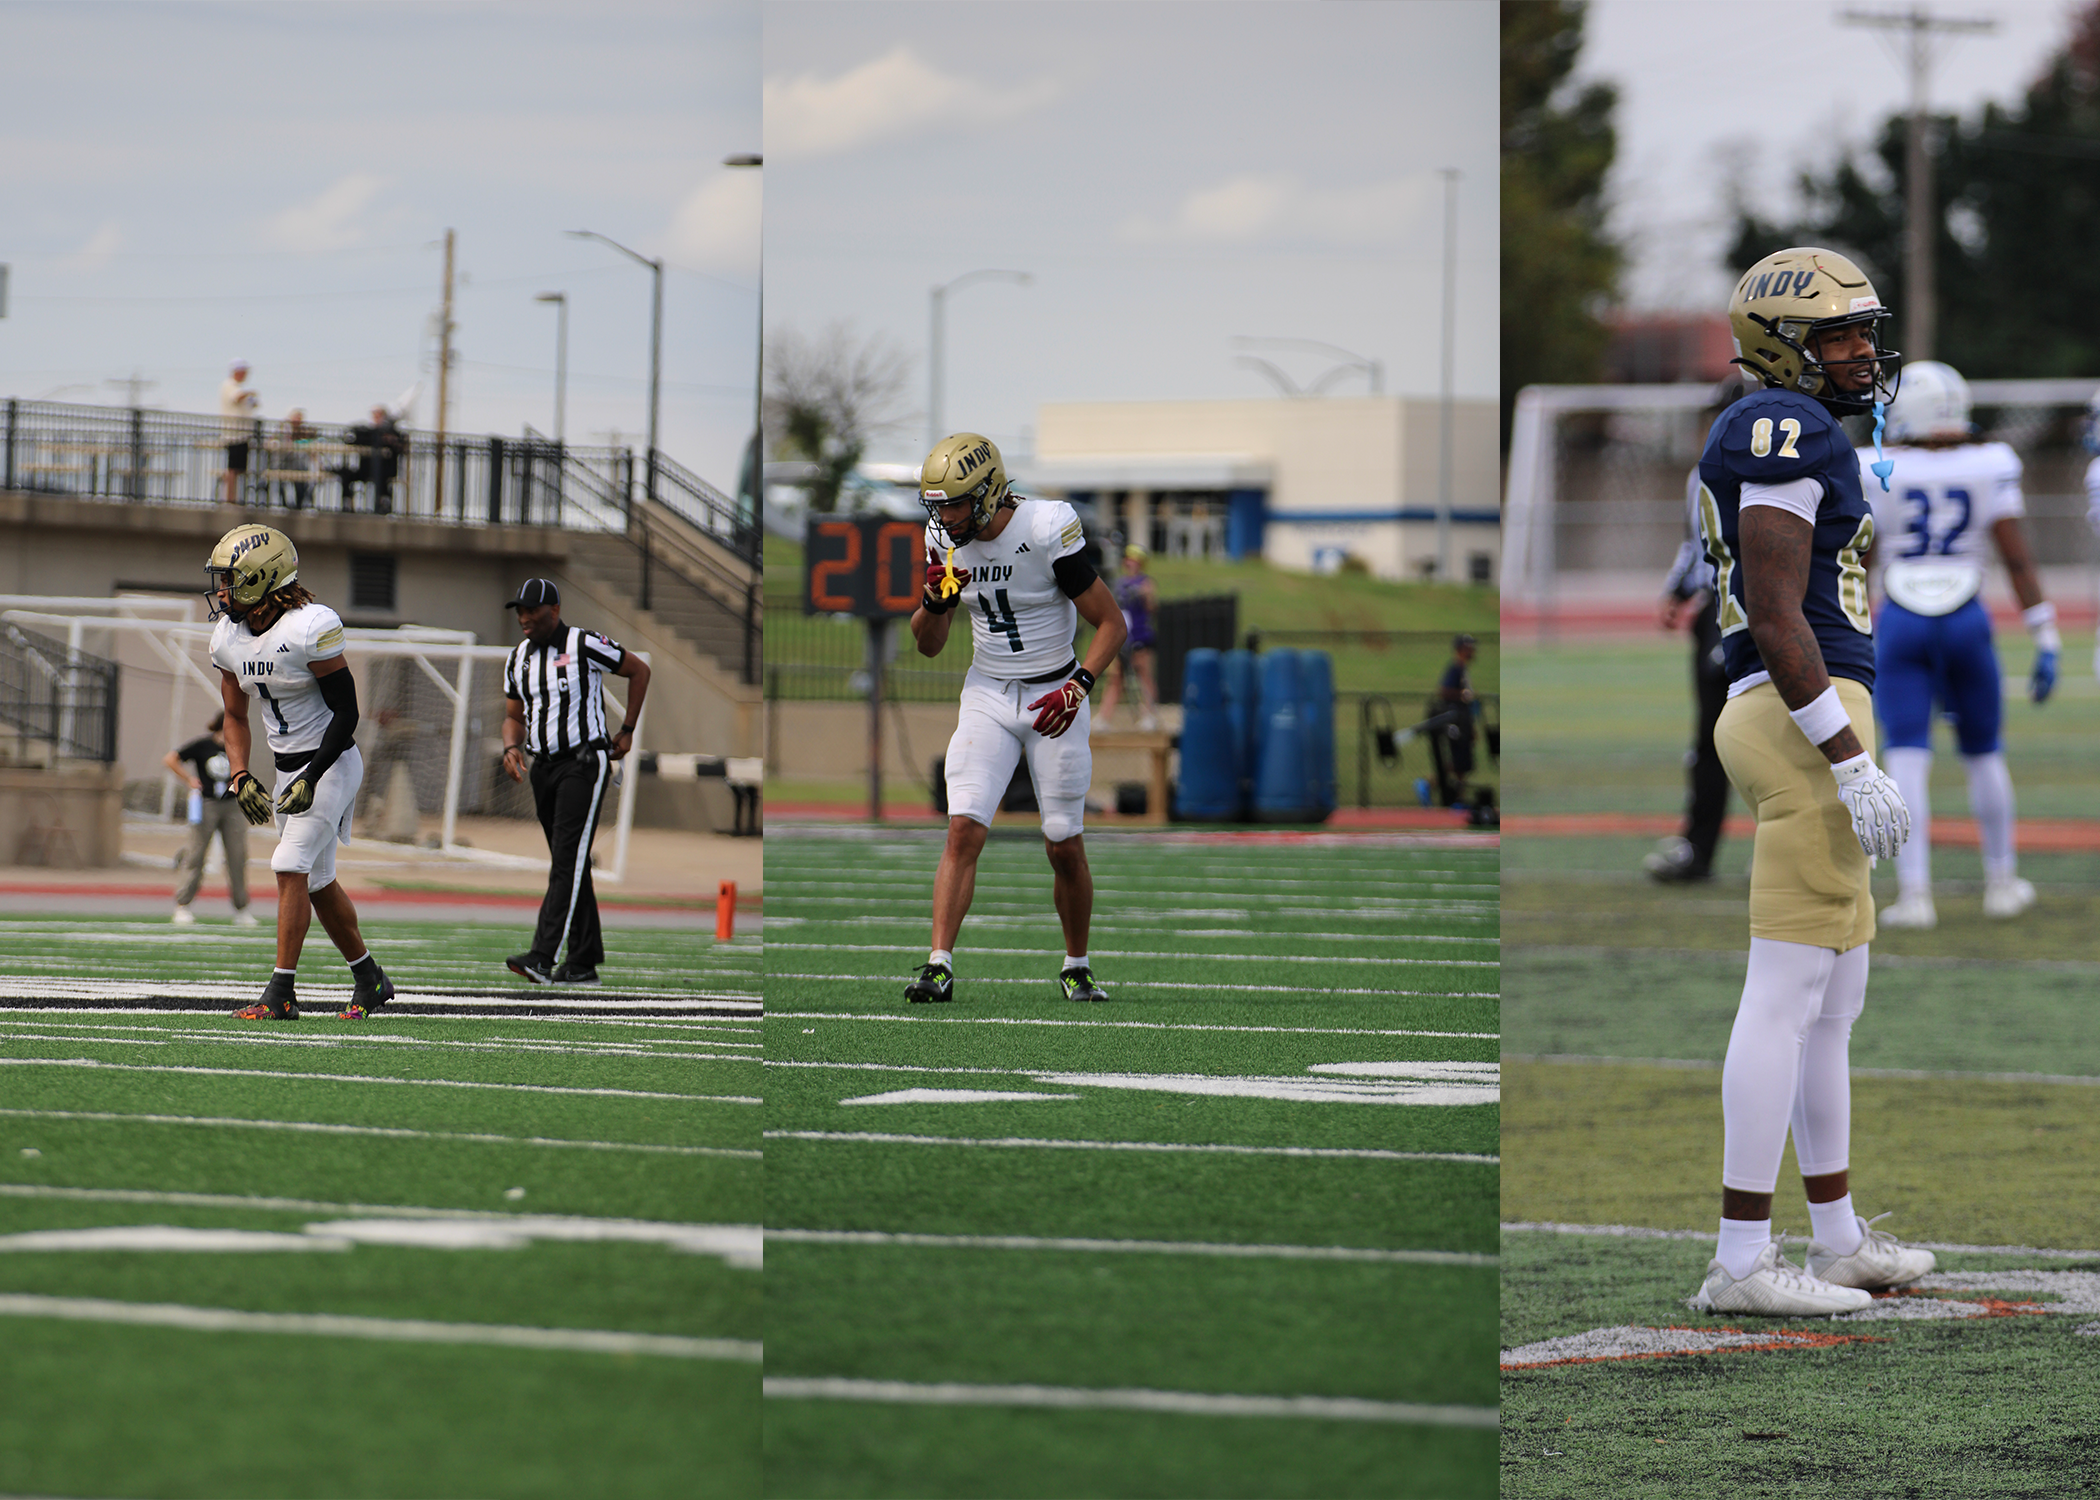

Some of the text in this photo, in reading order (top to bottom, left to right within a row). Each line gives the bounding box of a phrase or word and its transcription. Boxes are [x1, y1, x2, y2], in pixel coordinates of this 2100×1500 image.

[1743, 270, 1814, 303] INDY
[1751, 417, 1801, 458] 82
[957, 443, 991, 477] INDY
[1901, 488, 1970, 557] 32
[811, 521, 925, 612] 20
[972, 565, 1012, 582] INDY
[978, 588, 1024, 652] 4
[243, 661, 273, 675] INDY
[558, 677, 568, 692] C
[254, 682, 288, 734] 1
